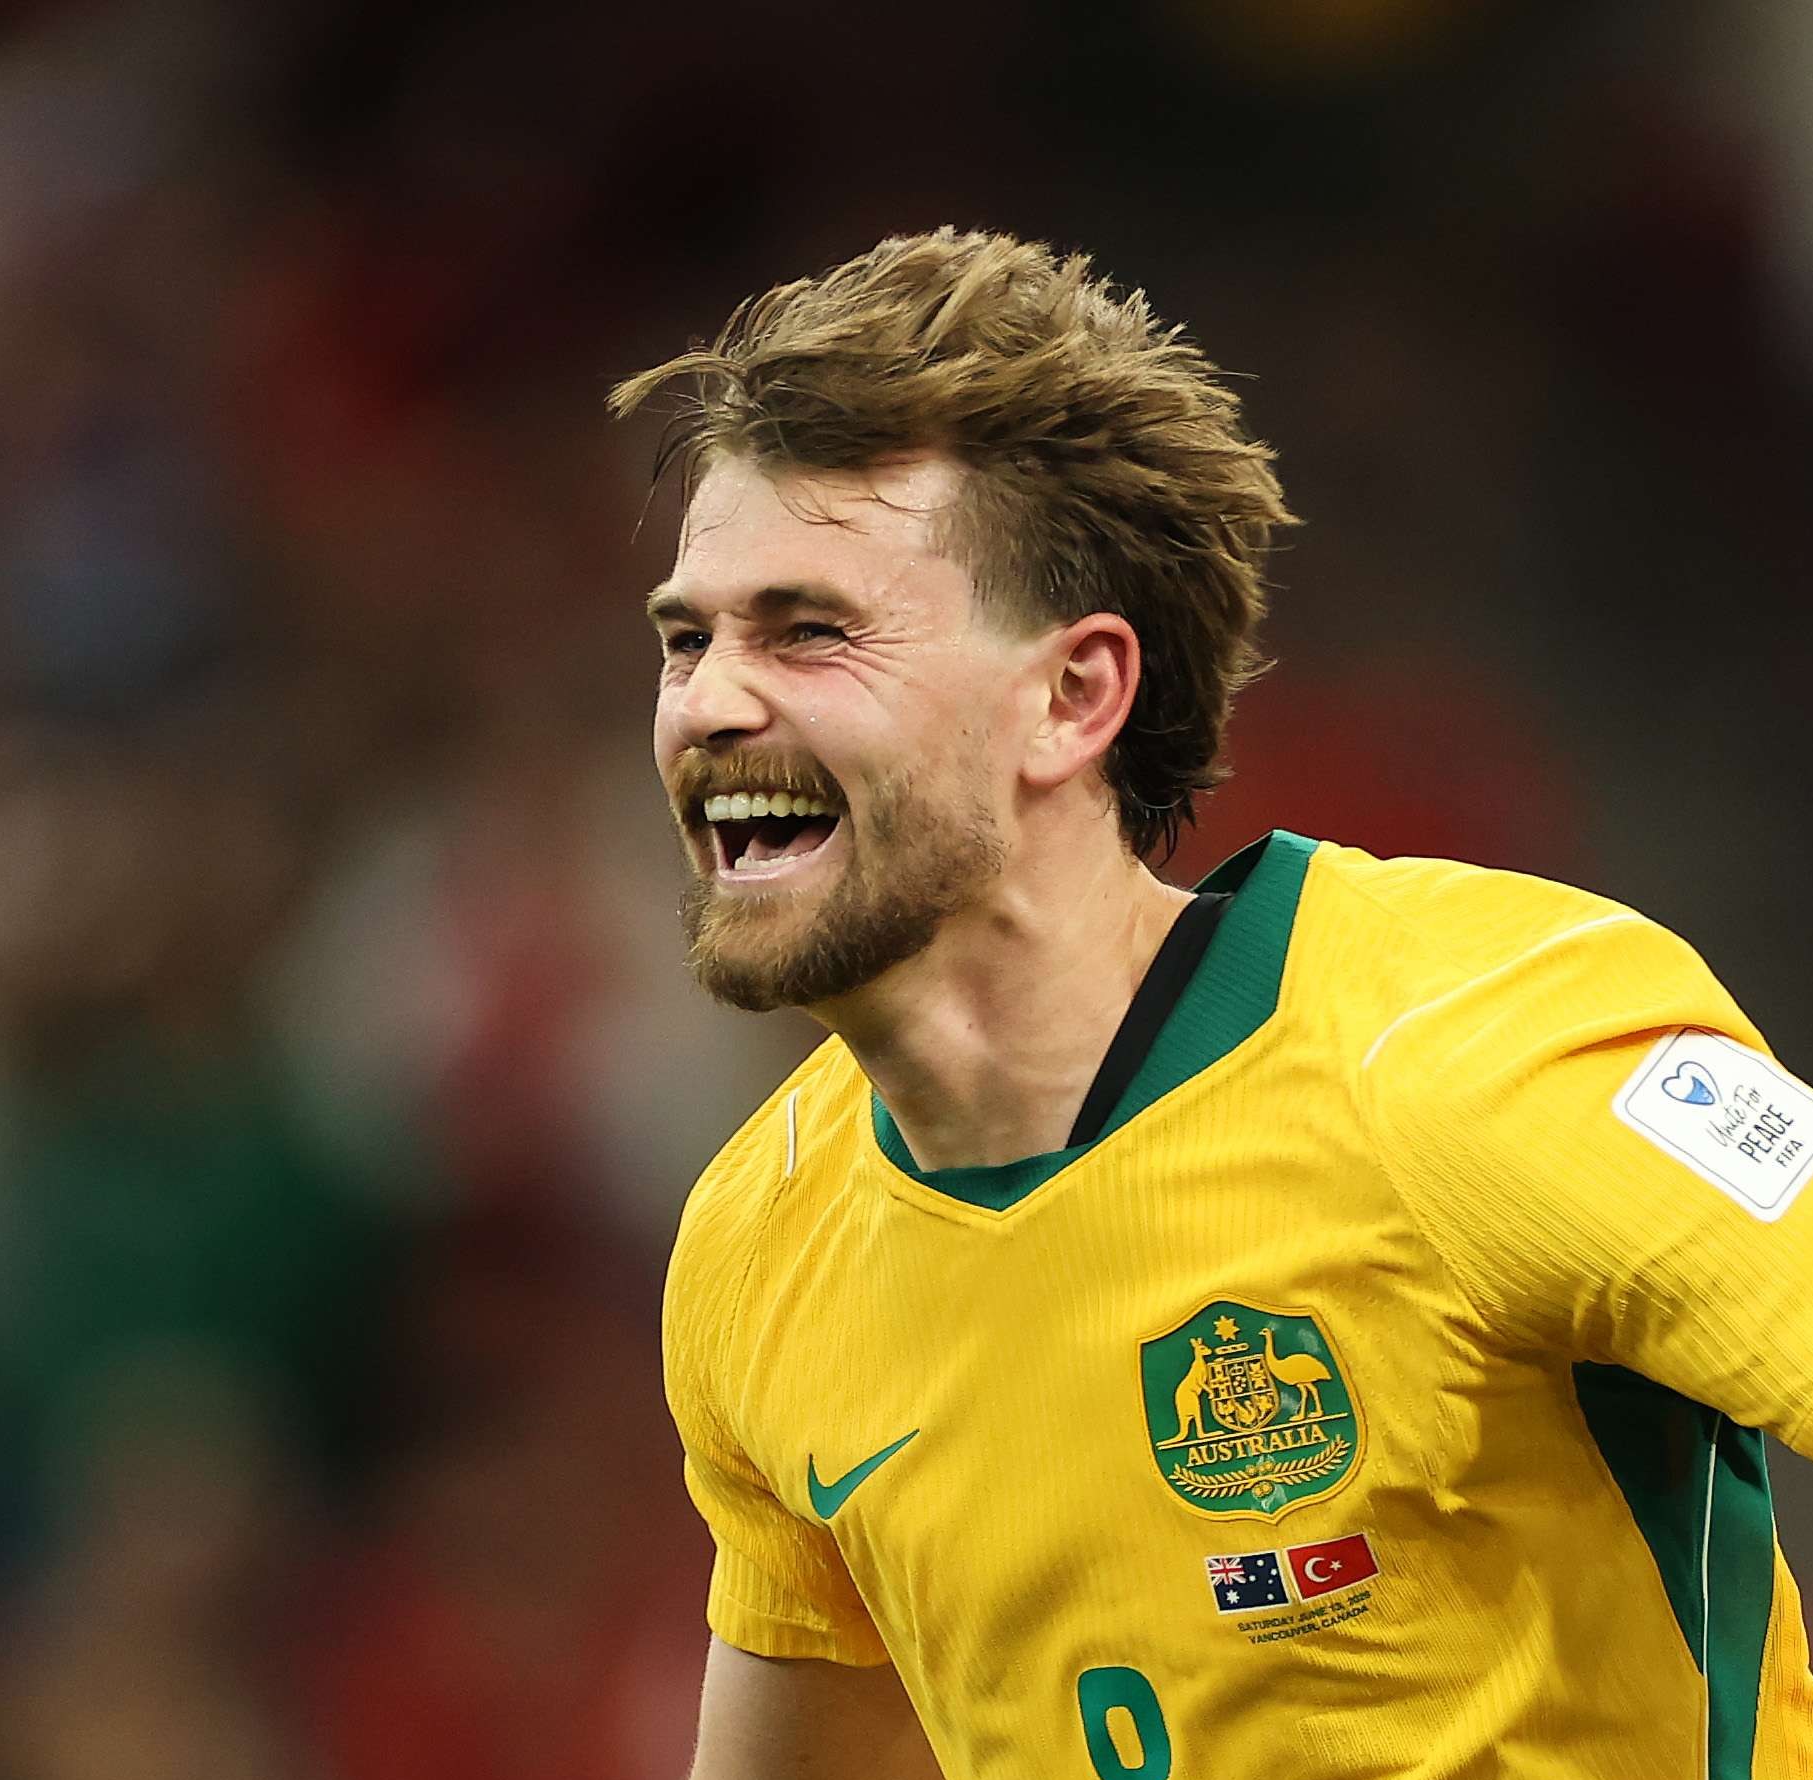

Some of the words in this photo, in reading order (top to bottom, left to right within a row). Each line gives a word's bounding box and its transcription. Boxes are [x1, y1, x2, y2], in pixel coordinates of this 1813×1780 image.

[1706, 1104, 1747, 1147] Unite
[1734, 1084, 1762, 1112] For
[1738, 1104, 1794, 1164] PEACE
[1776, 1140, 1804, 1168] FIFA
[1186, 1423, 1330, 1467] AUSTRALIA
[1321, 1604, 1369, 1628] CANADA
